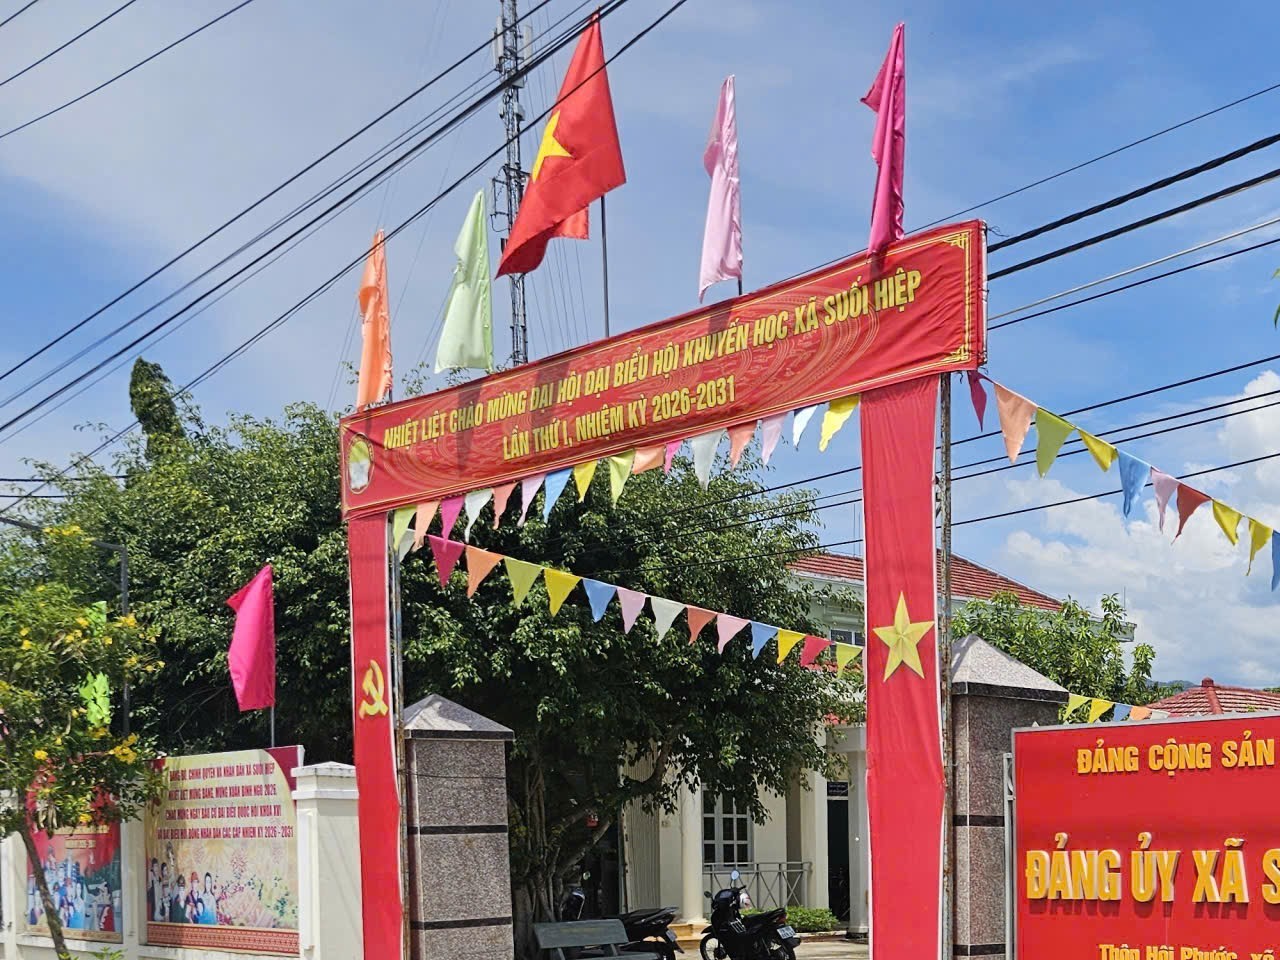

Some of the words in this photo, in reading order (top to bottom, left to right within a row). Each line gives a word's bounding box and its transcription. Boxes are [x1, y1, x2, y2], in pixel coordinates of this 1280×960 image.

[383, 418, 420, 450] NHIỆT
[421, 410, 448, 442] LIỆT
[449, 400, 484, 433] CHÀO
[486, 390, 528, 424] MỪNG
[530, 382, 554, 414] ĐẠI
[556, 371, 582, 406] HỘI
[584, 366, 611, 399] ĐẠI
[613, 347, 649, 388] BIỂU
[651, 342, 680, 379] HỘI
[682, 318, 750, 368] KHUYẾN
[752, 310, 789, 349] HỌC
[793, 296, 819, 335] XÃ
[823, 275, 869, 327] SUỐI
[873, 267, 922, 313] HIỆP
[502, 424, 530, 461] LẦN
[532, 417, 562, 453] THỨ
[561, 419, 573, 448] I,
[575, 403, 625, 441] NHIỆM
[627, 393, 648, 429] KỲ
[651, 374, 735, 423] 2026-2031
[1076, 738, 1139, 774] ĐẢNG
[1148, 737, 1212, 778] CỘNG
[1221, 730, 1275, 768] SẢN
[1025, 832, 1123, 901] ĐẢNG
[1131, 832, 1181, 903] ỦY
[1192, 837, 1250, 903] XÃ
